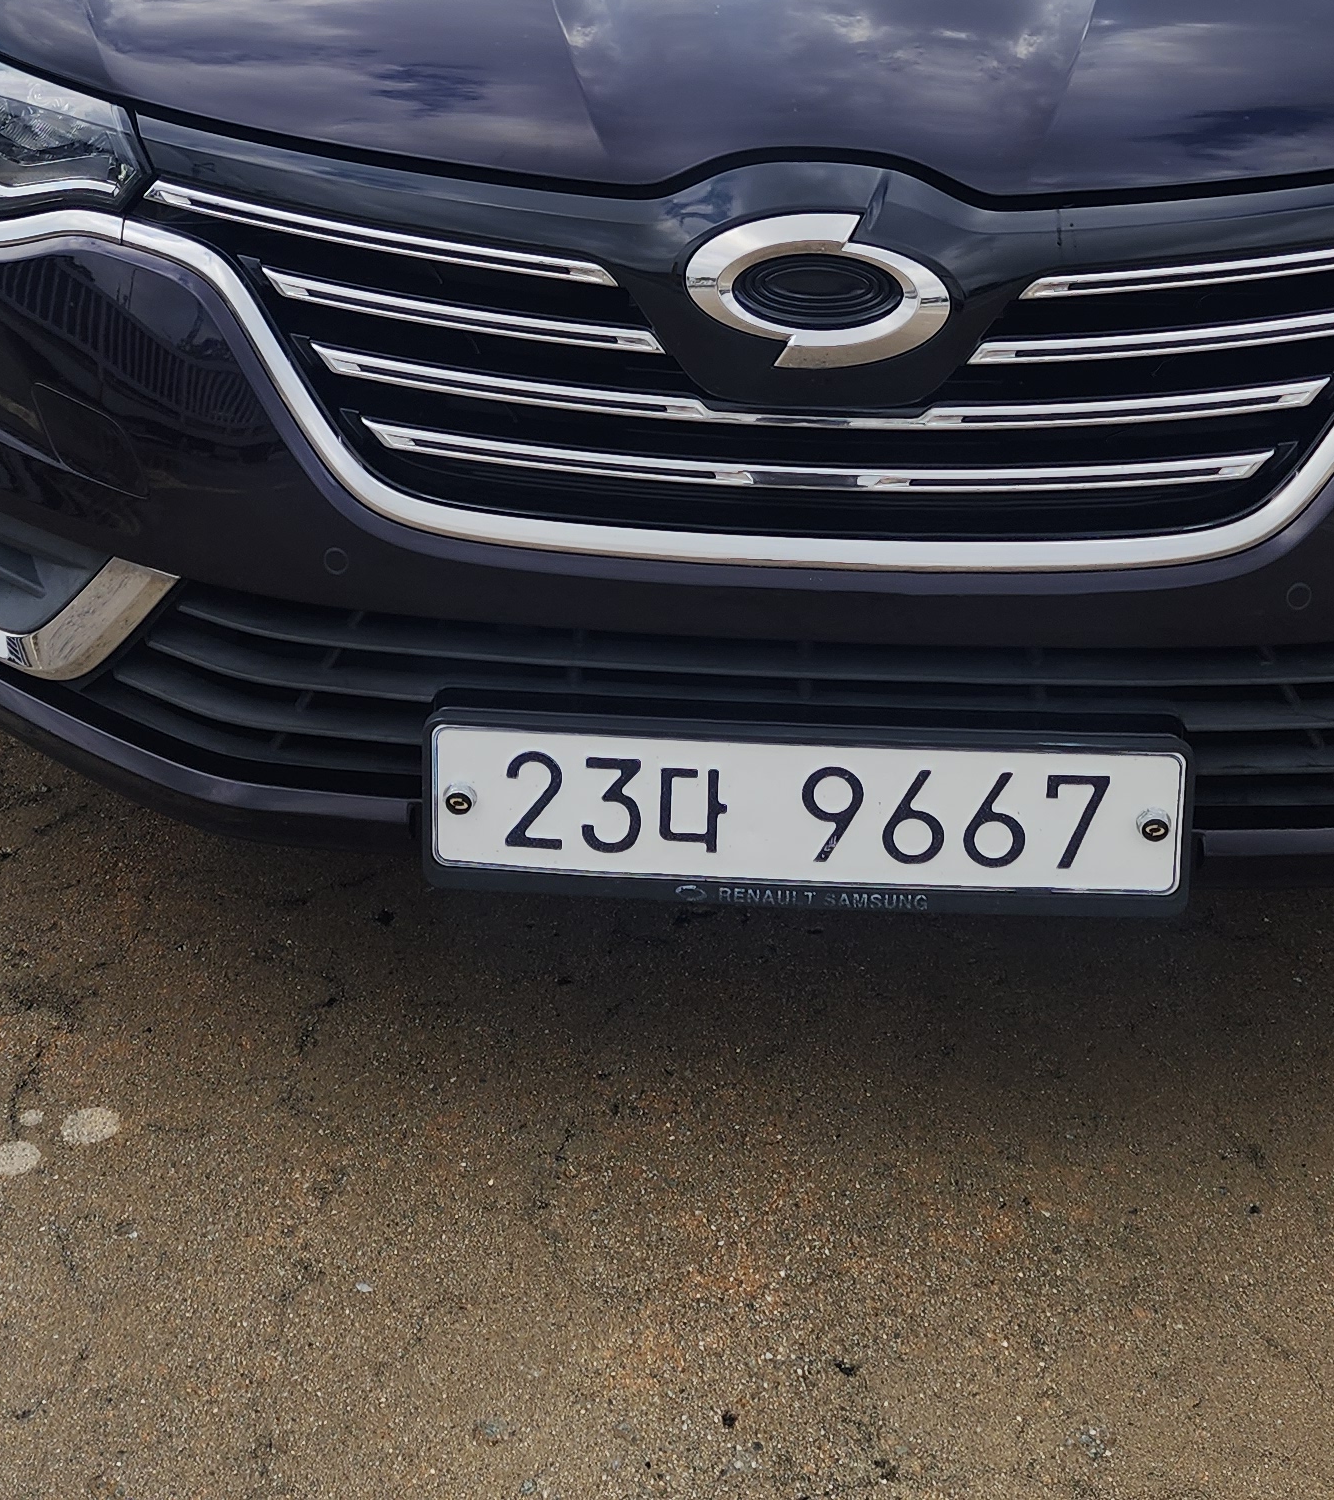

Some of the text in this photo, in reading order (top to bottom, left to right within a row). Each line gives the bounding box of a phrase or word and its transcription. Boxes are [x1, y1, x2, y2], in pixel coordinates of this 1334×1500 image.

[504, 750, 1111, 870] 23다 9667
[718, 887, 929, 911] RENAULT SAMSUNG
